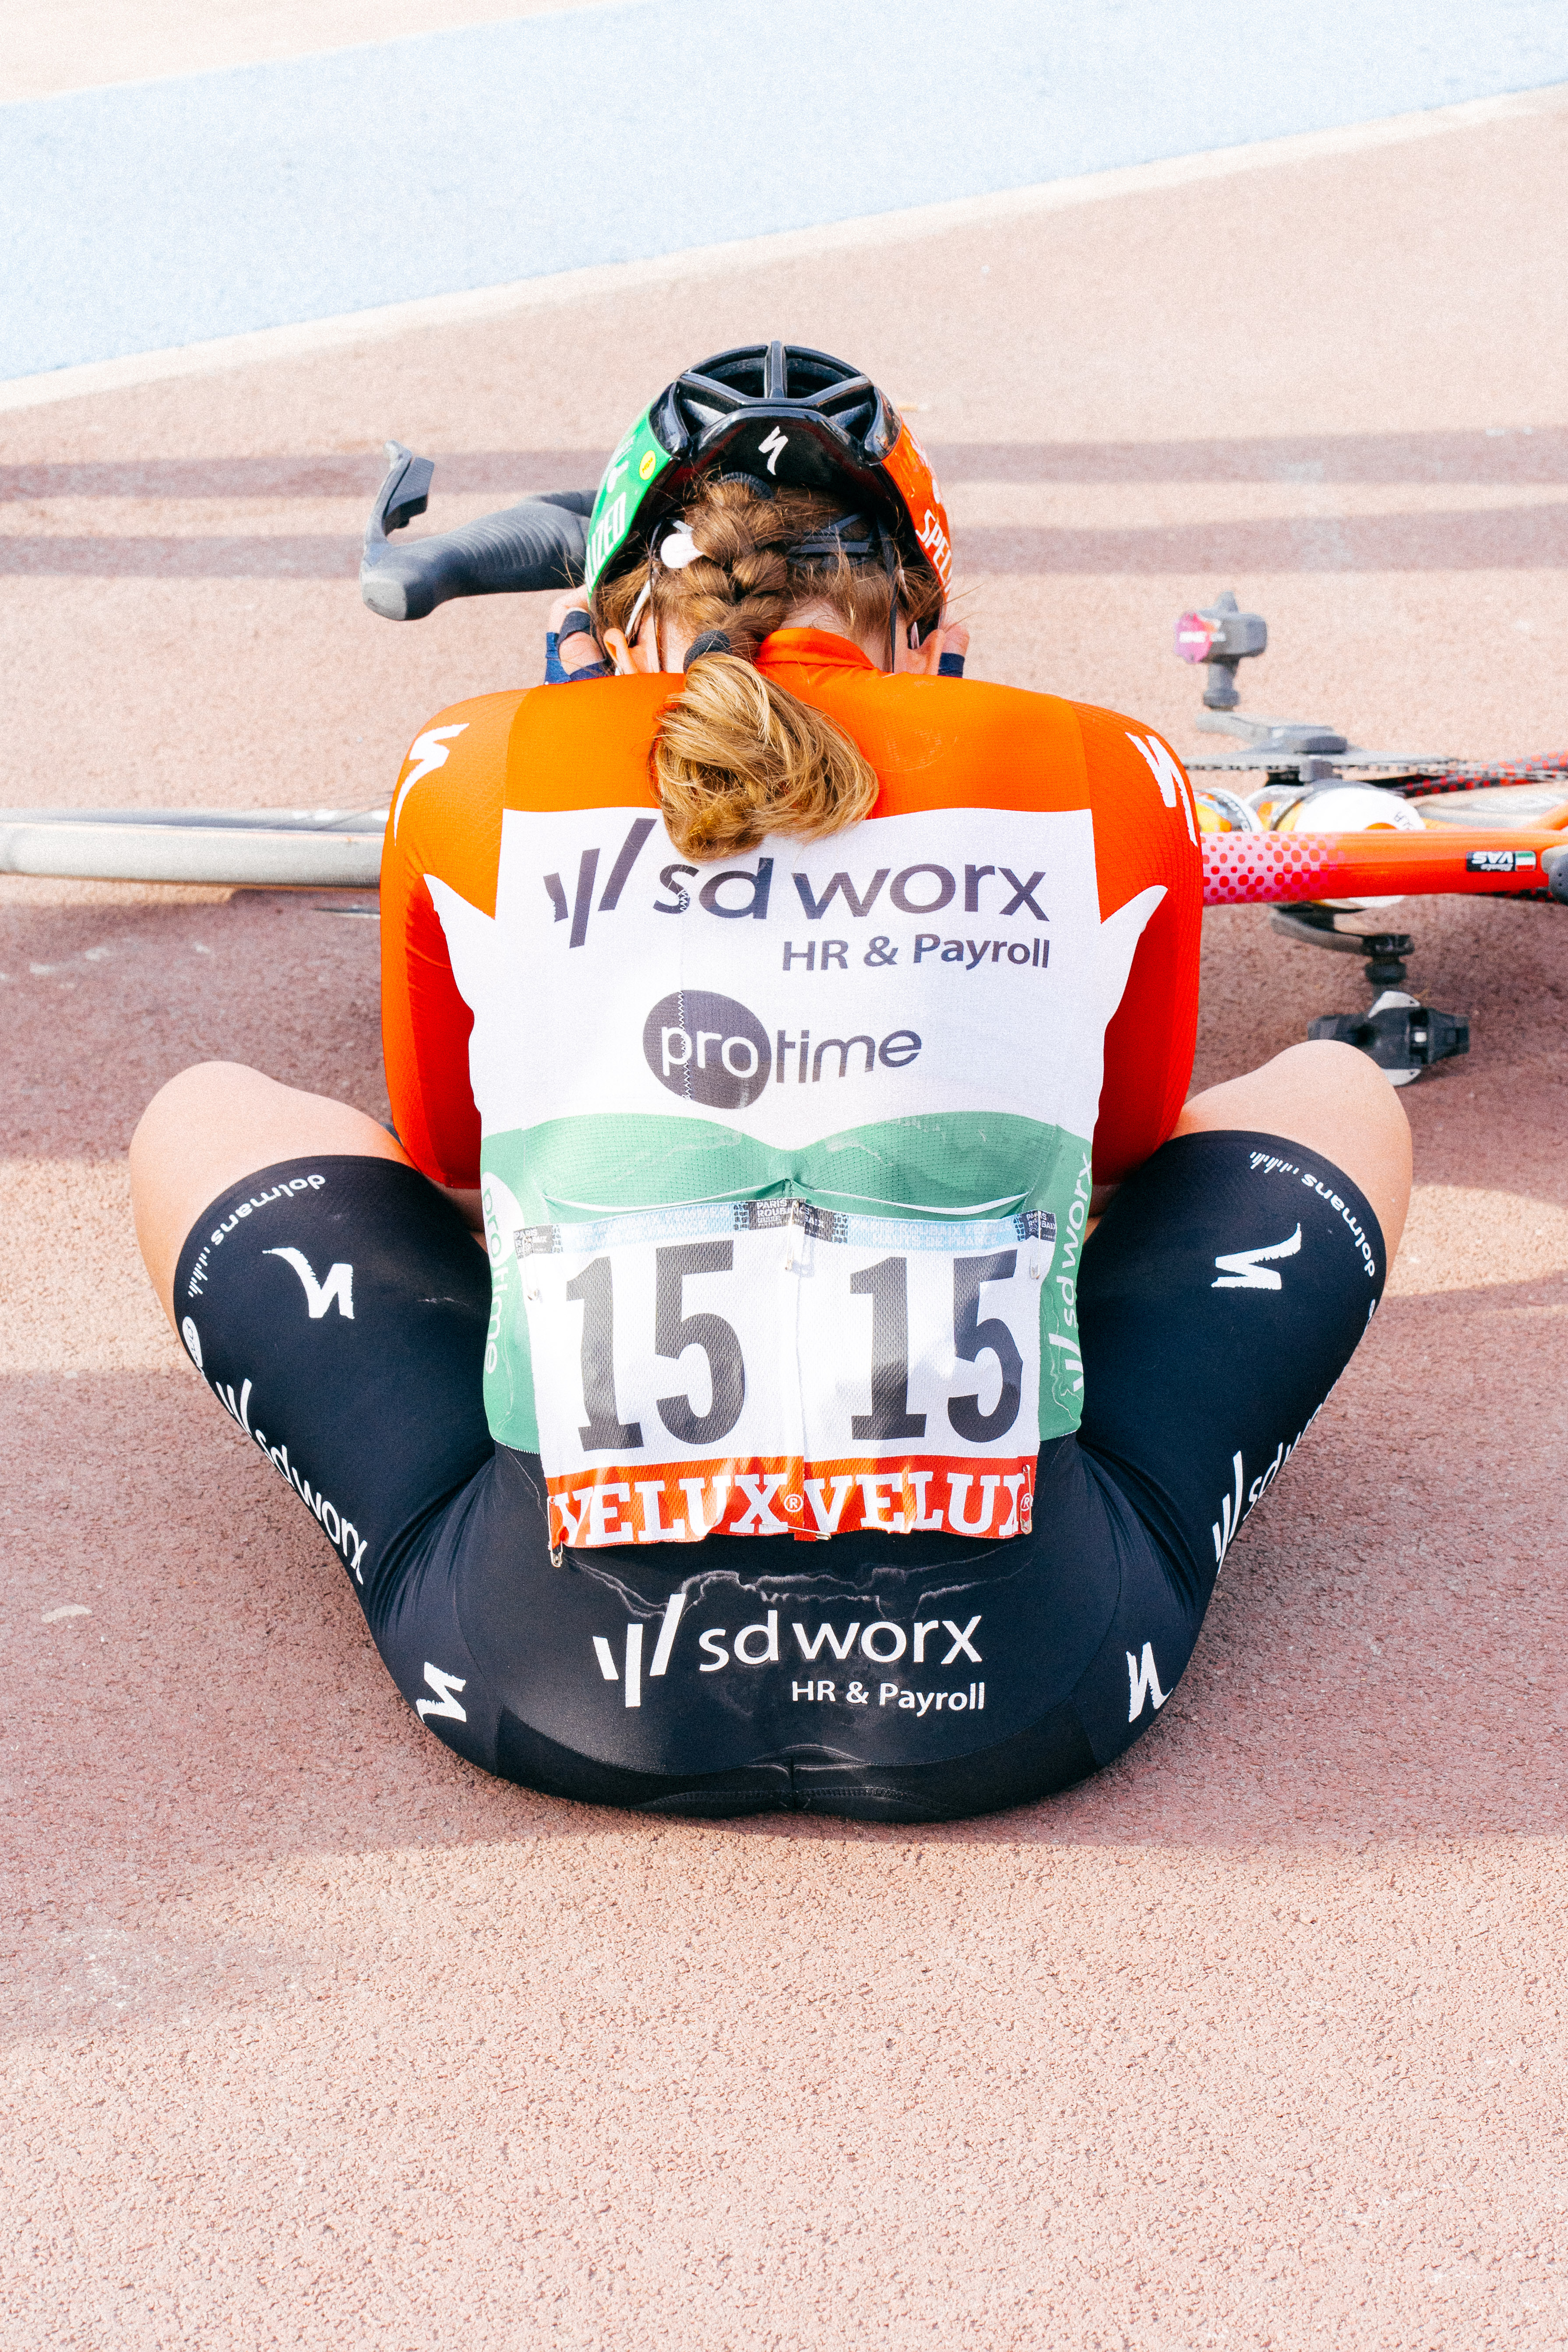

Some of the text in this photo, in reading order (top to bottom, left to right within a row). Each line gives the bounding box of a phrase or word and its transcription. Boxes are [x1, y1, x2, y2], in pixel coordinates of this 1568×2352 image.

[653, 857, 1050, 922] sd worx
[1472, 851, 1514, 864] VAS
[782, 933, 1050, 971] HR & Payroll
[661, 1026, 923, 1084] protime
[211, 1174, 325, 1245] dolmans
[757, 1199, 787, 1210] PARIS
[1062, 1153, 1091, 1268] worx
[1301, 1174, 1375, 1277] dolmans
[566, 1240, 745, 1452] 15
[850, 1249, 1023, 1443] 15
[291, 1467, 368, 1585] worx
[699, 1609, 982, 1671] sd worx
[792, 1680, 985, 1717] HR & Payroll
